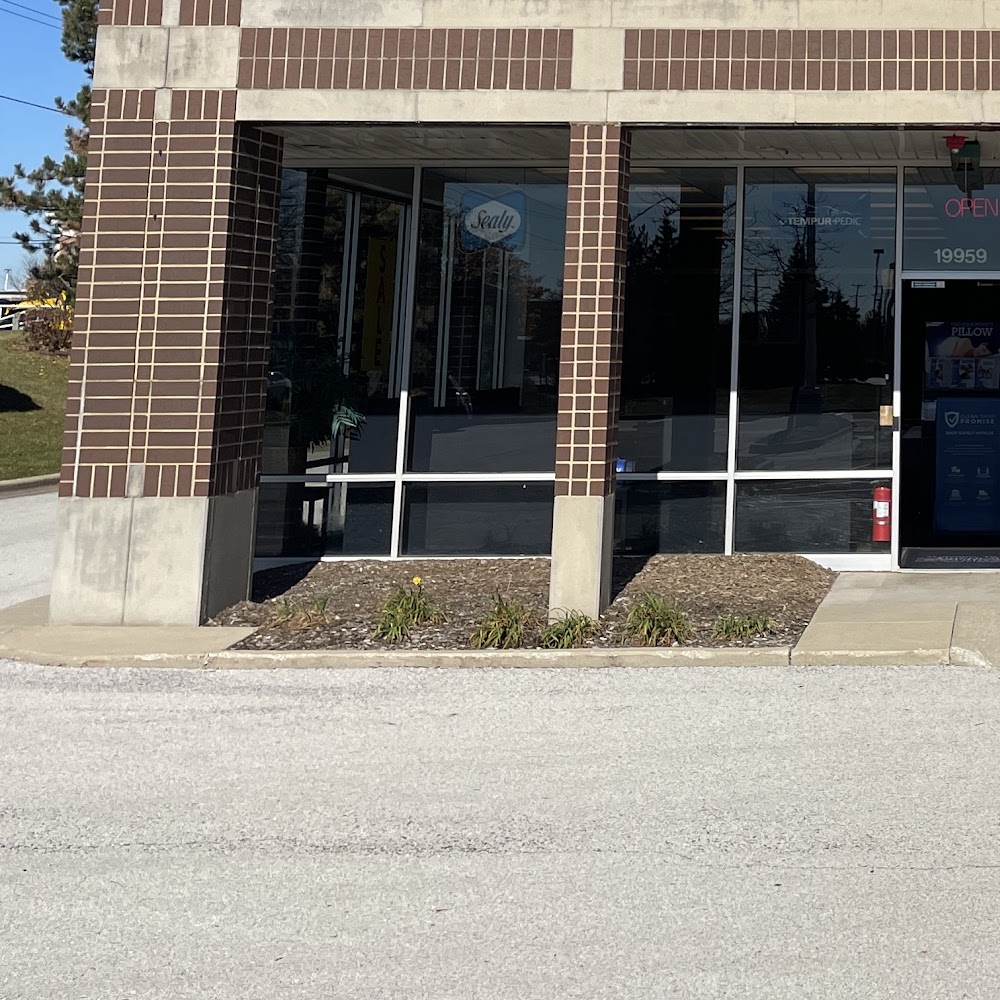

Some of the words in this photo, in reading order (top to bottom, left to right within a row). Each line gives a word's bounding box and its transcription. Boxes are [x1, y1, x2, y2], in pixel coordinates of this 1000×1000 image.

[945, 197, 999, 218] OPEN
[471, 209, 514, 233] Sealy
[933, 247, 987, 264] 19959
[951, 327, 993, 337] PILLOW
